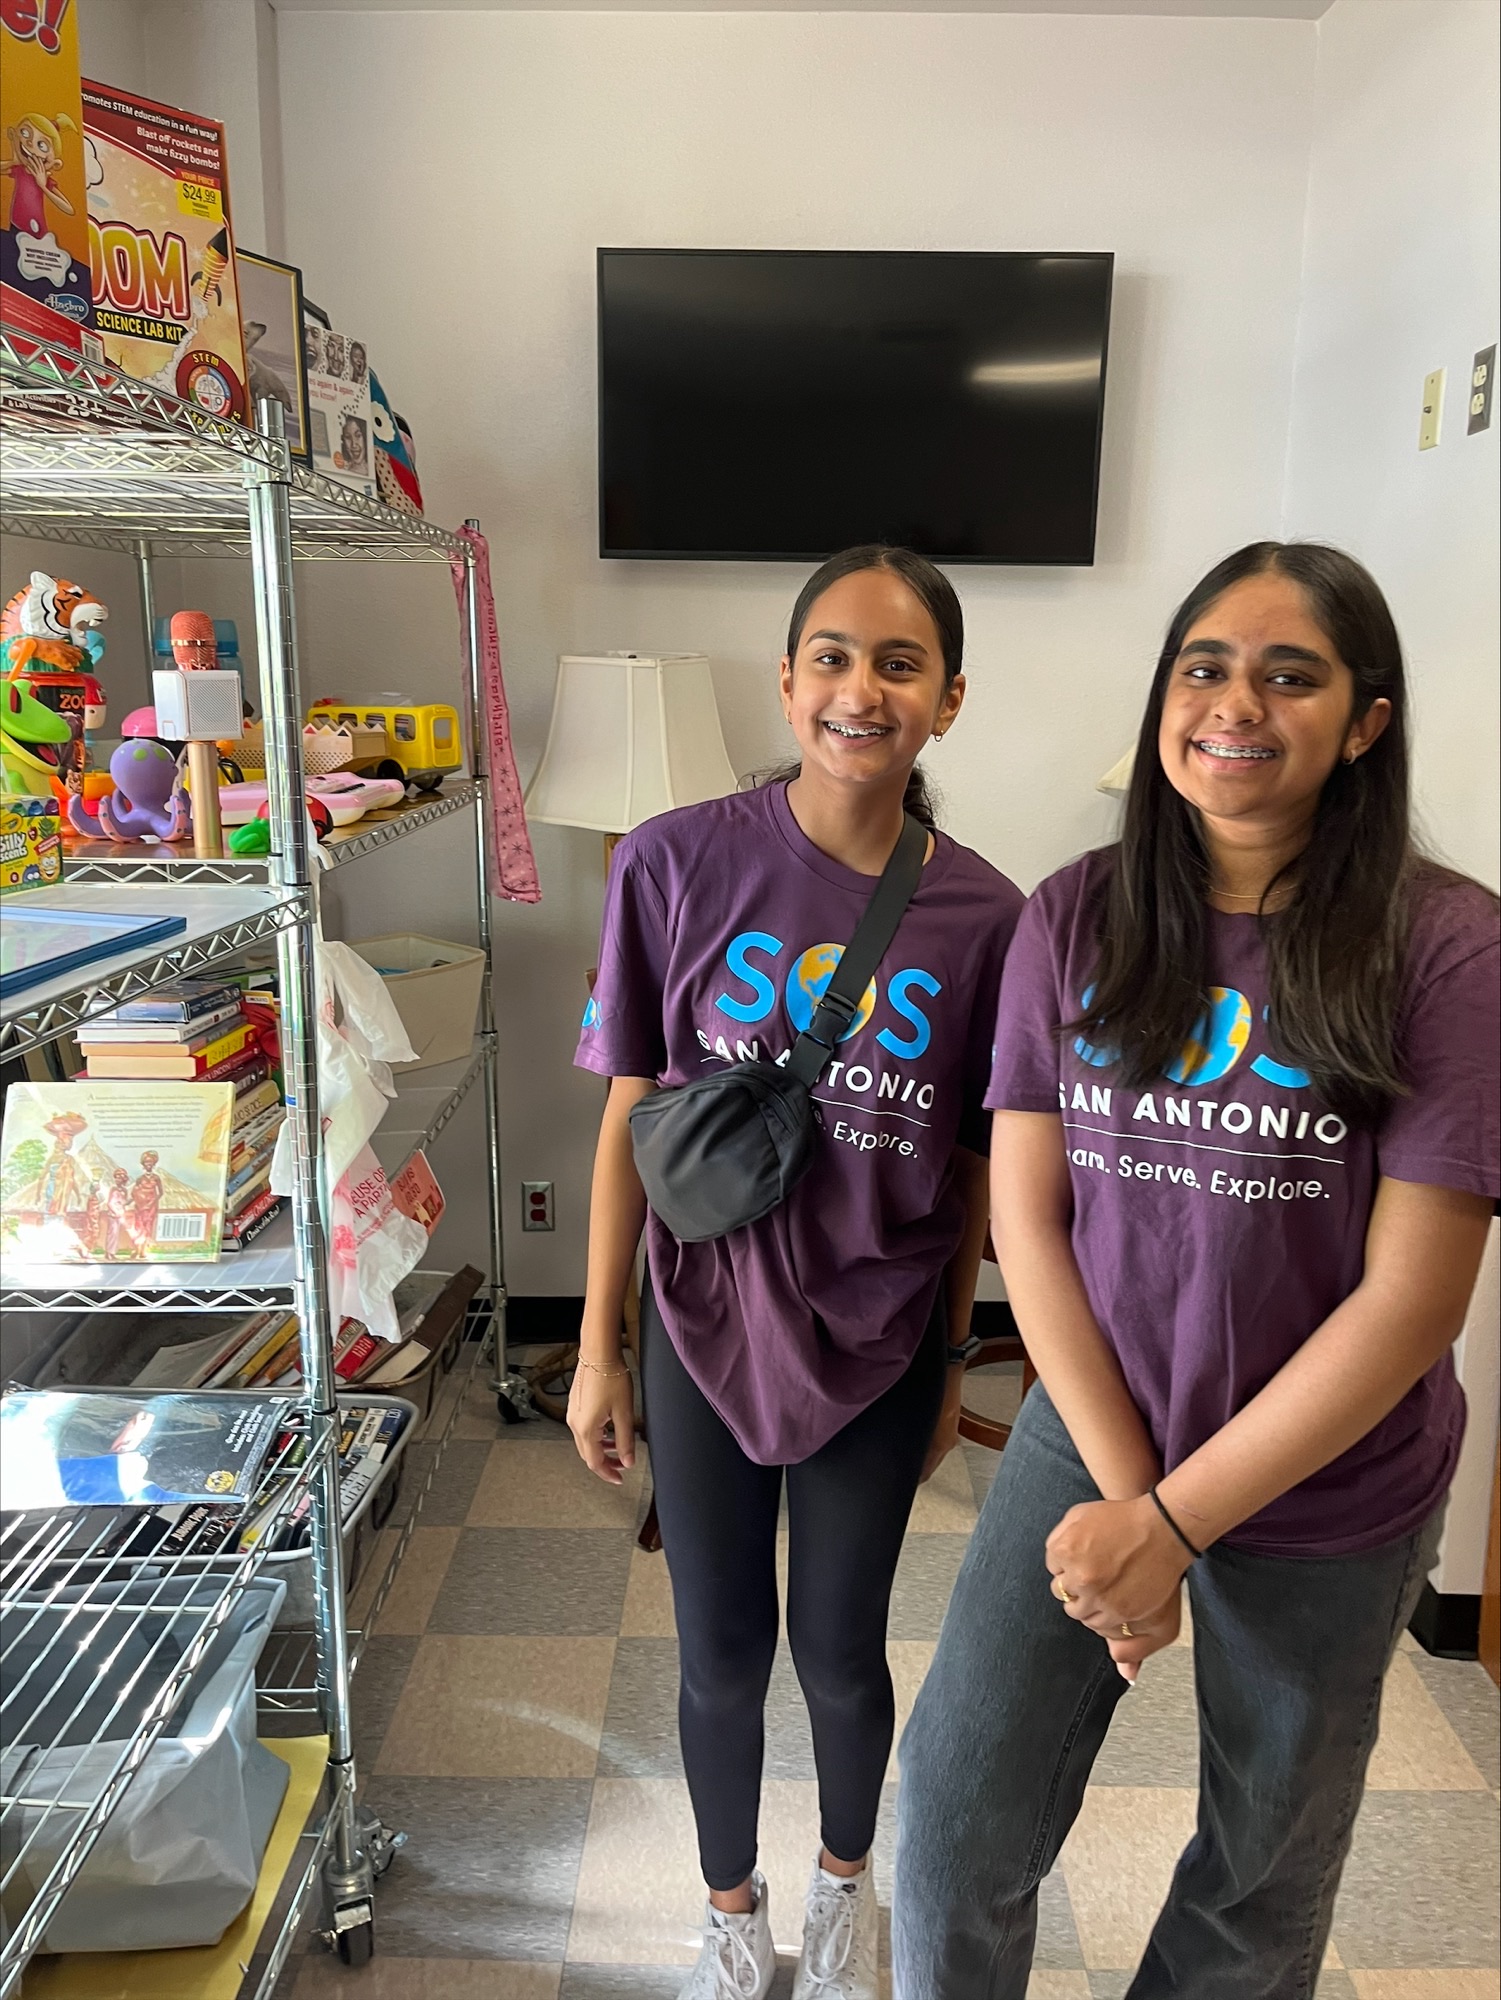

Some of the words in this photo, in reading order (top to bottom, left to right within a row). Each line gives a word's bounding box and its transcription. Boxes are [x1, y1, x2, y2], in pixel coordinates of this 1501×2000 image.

[0, 0, 67, 52] e!
[81, 93, 112, 109] romotes
[112, 102, 133, 116] STEM
[134, 110, 170, 127] education
[171, 119, 179, 130] in
[179, 123, 185, 131] a
[185, 124, 199, 135] fun
[199, 127, 218, 142] way!
[136, 126, 158, 141] Blast
[159, 133, 172, 144] off
[172, 137, 202, 153] rockets
[203, 145, 219, 158] and
[146, 143, 168, 156] make
[169, 148, 189, 164] fizzy
[190, 153, 220, 170] bombs!
[180, 171, 198, 182] YOUR
[198, 175, 215, 187] PRICE
[183, 183, 217, 202] $24.99
[88, 220, 190, 319] OM
[45, 296, 85, 312] Hasbro
[96, 312, 142, 335] SCIENCE
[143, 321, 164, 338] LAB
[165, 325, 184, 342] KIT
[0, 832, 26, 853] Silly
[714, 930, 943, 1060] SOS
[696, 1028, 760, 1063] SAN
[1132, 1092, 1347, 1145] ANTONIO
[351, 1178, 377, 1206] EUSE
[1117, 1155, 1201, 1190] Serve.
[1210, 1170, 1330, 1203] Explore.
[341, 1474, 371, 1508] FRID
